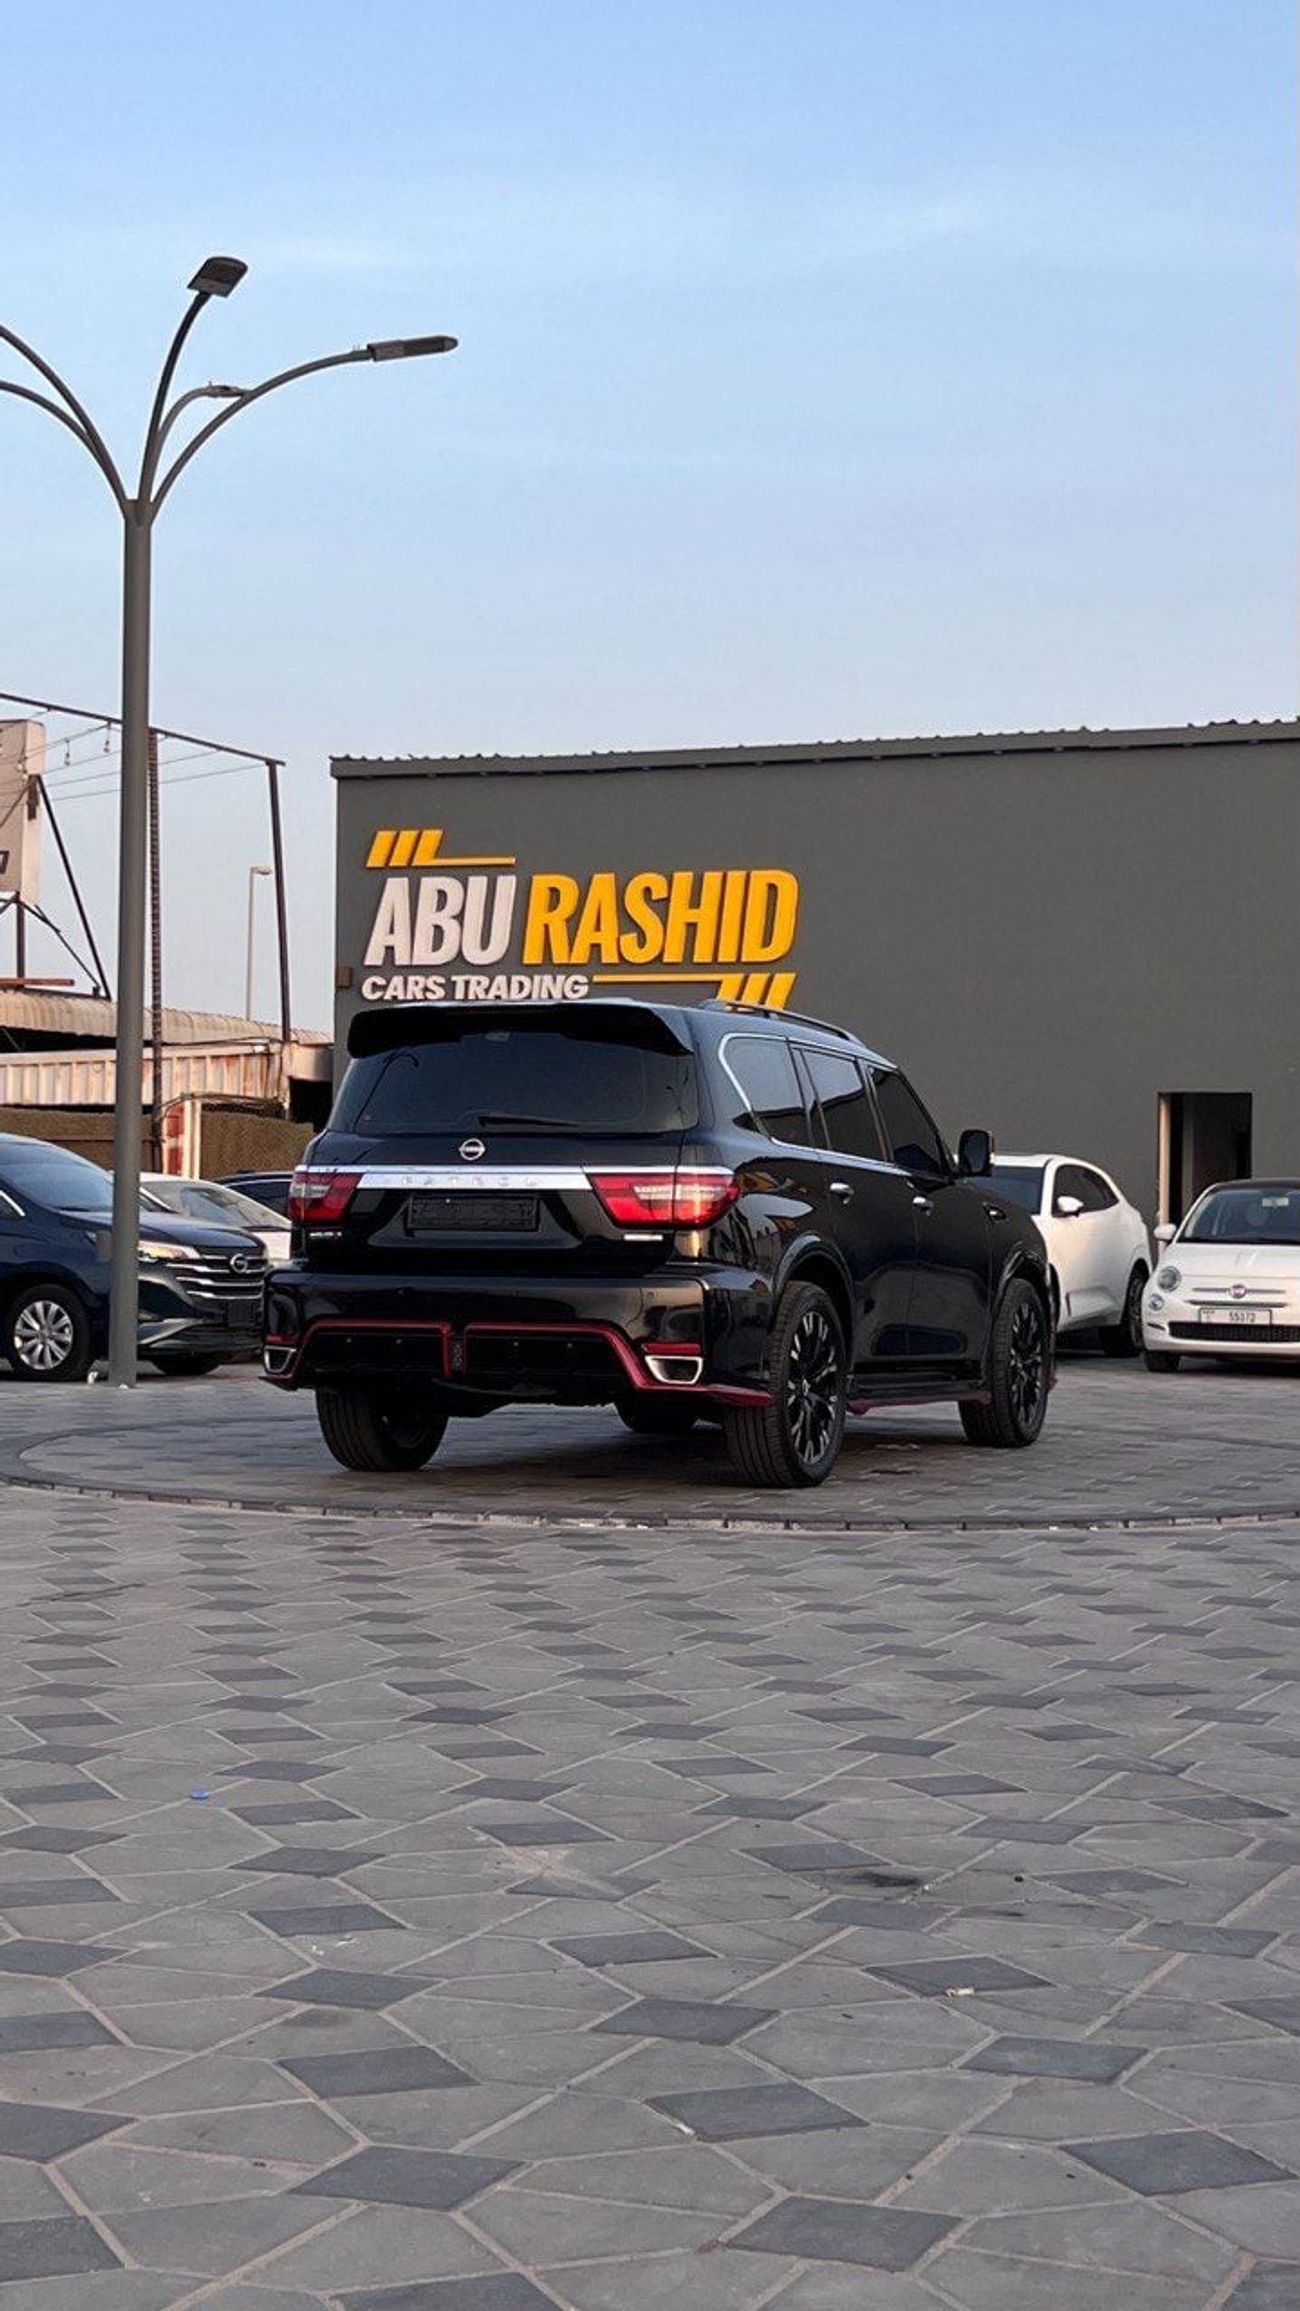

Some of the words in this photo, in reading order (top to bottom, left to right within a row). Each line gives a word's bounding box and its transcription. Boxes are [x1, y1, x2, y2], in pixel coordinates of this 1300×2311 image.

[364, 875, 516, 966] ABU
[523, 869, 799, 964] RASHID
[362, 975, 446, 1000] CARS
[451, 974, 589, 1000] TRADING
